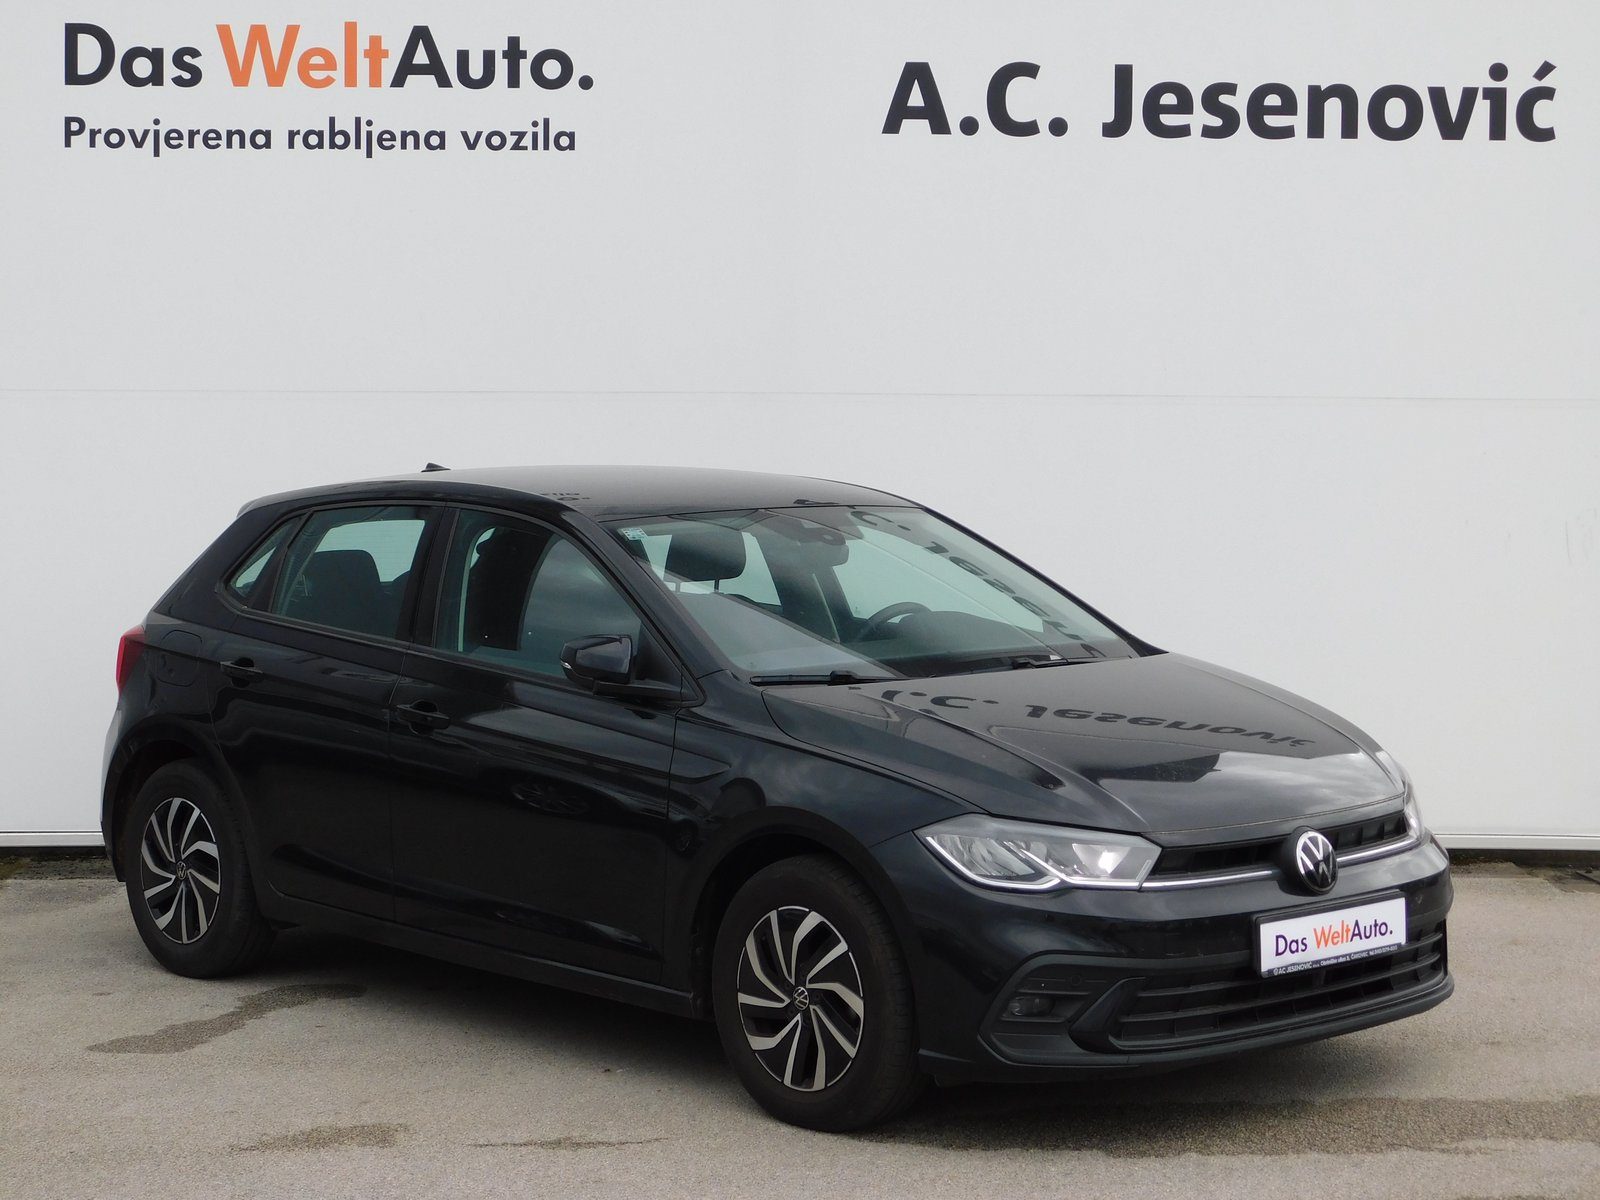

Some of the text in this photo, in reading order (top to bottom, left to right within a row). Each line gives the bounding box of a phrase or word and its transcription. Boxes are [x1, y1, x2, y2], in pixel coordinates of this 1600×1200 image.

[65, 21, 594, 91] Das WeltAuto.
[882, 60, 1557, 142] A.C. Jesenović
[64, 116, 576, 158] Provjerena rabljena vozila
[1275, 919, 1393, 957] Das WeltAuto.
